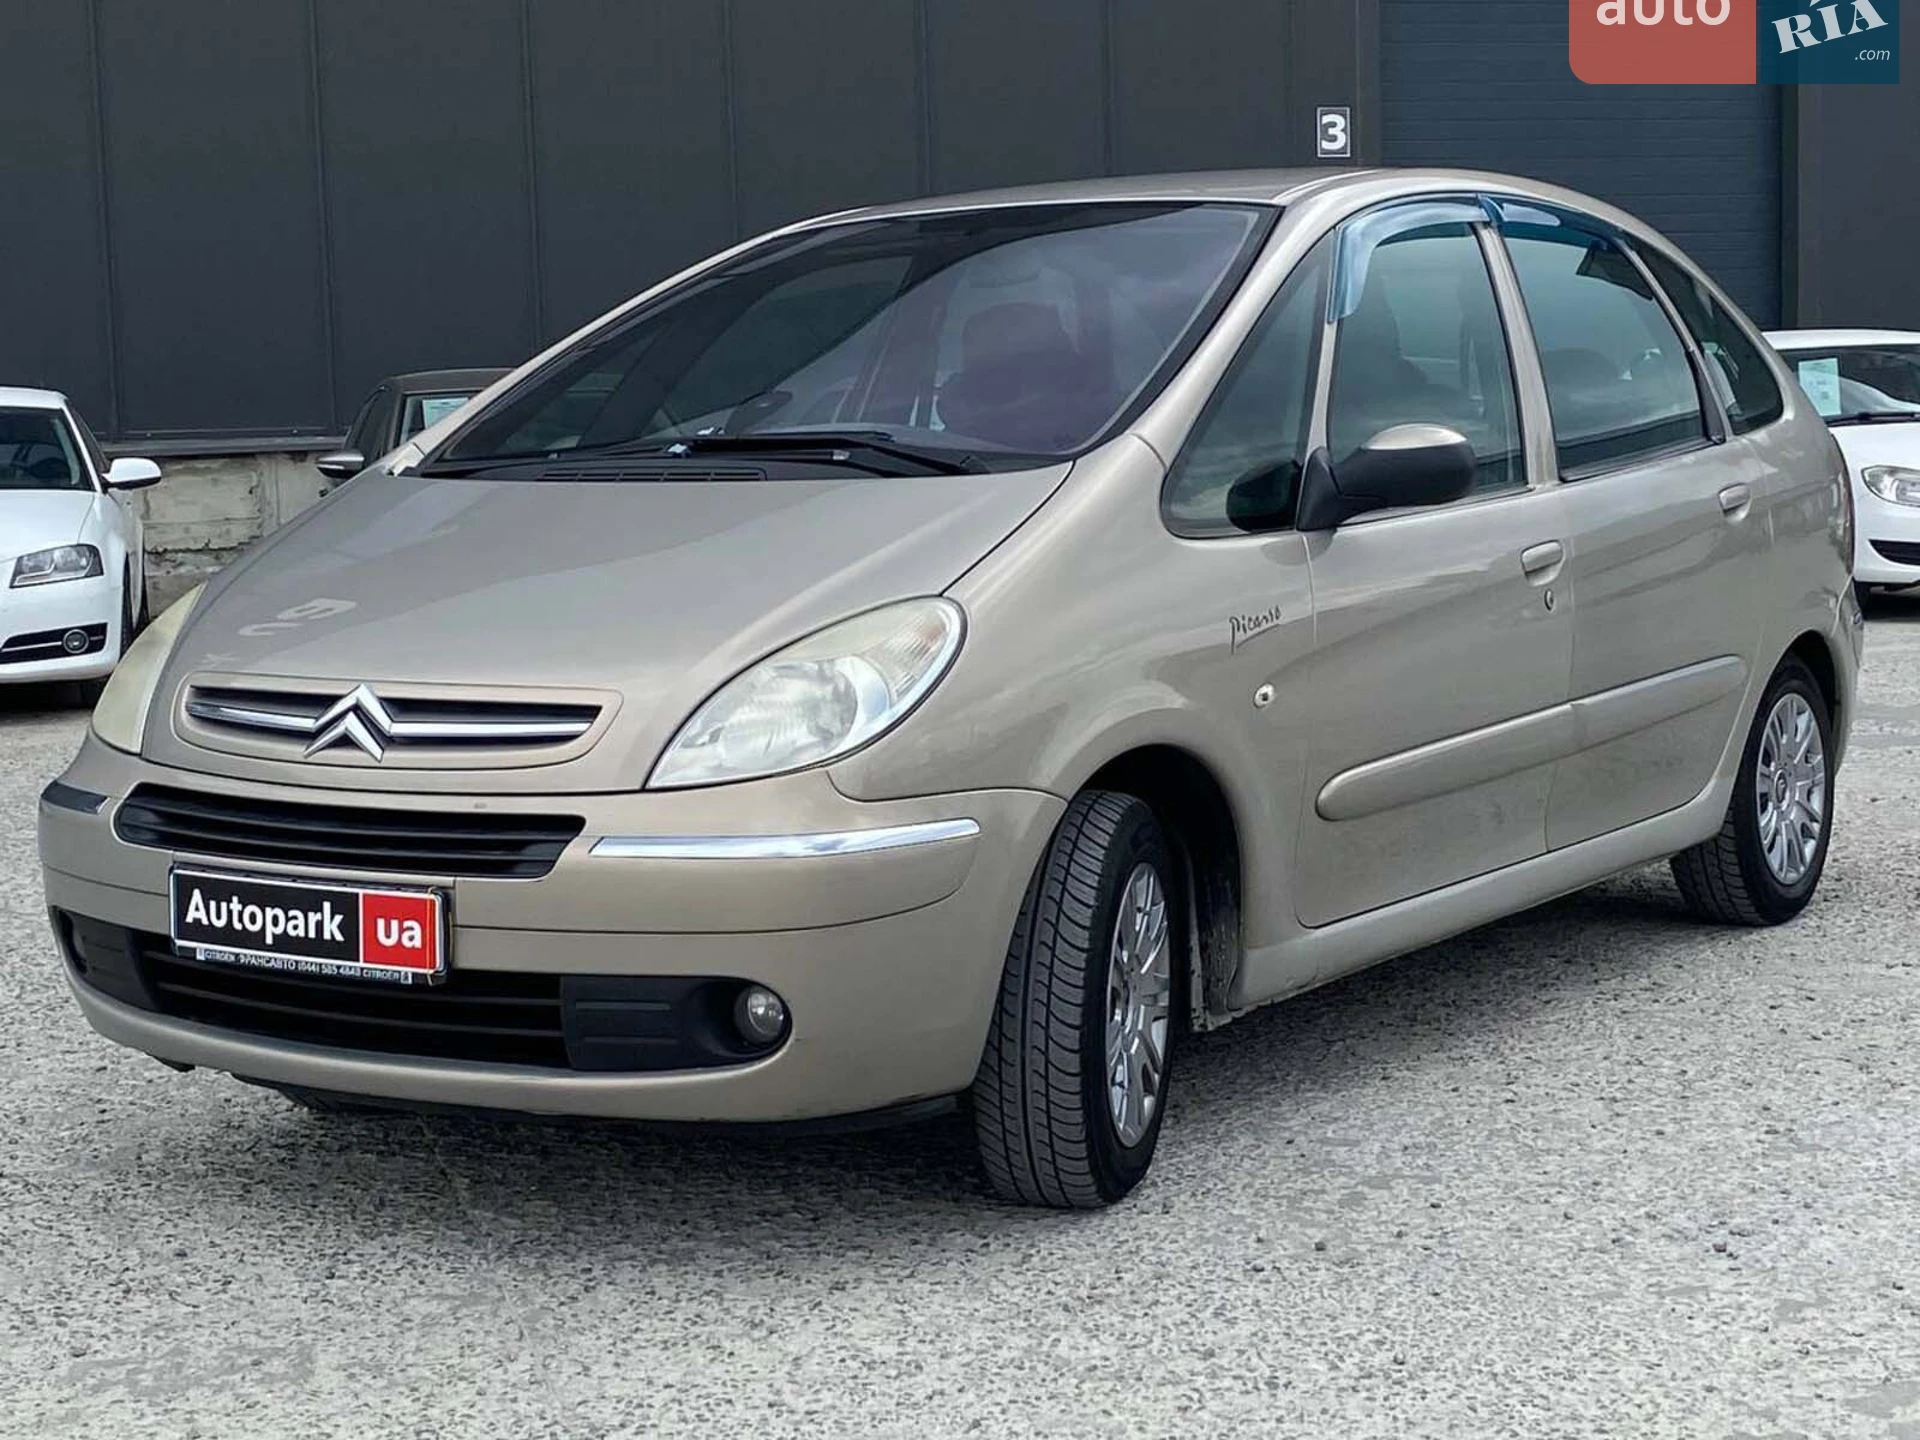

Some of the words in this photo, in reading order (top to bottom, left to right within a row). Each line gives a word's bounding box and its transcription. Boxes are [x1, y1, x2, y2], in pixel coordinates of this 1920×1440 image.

[1321, 113, 1346, 150] 3
[185, 888, 345, 945] Autopark
[376, 917, 422, 948] ua
